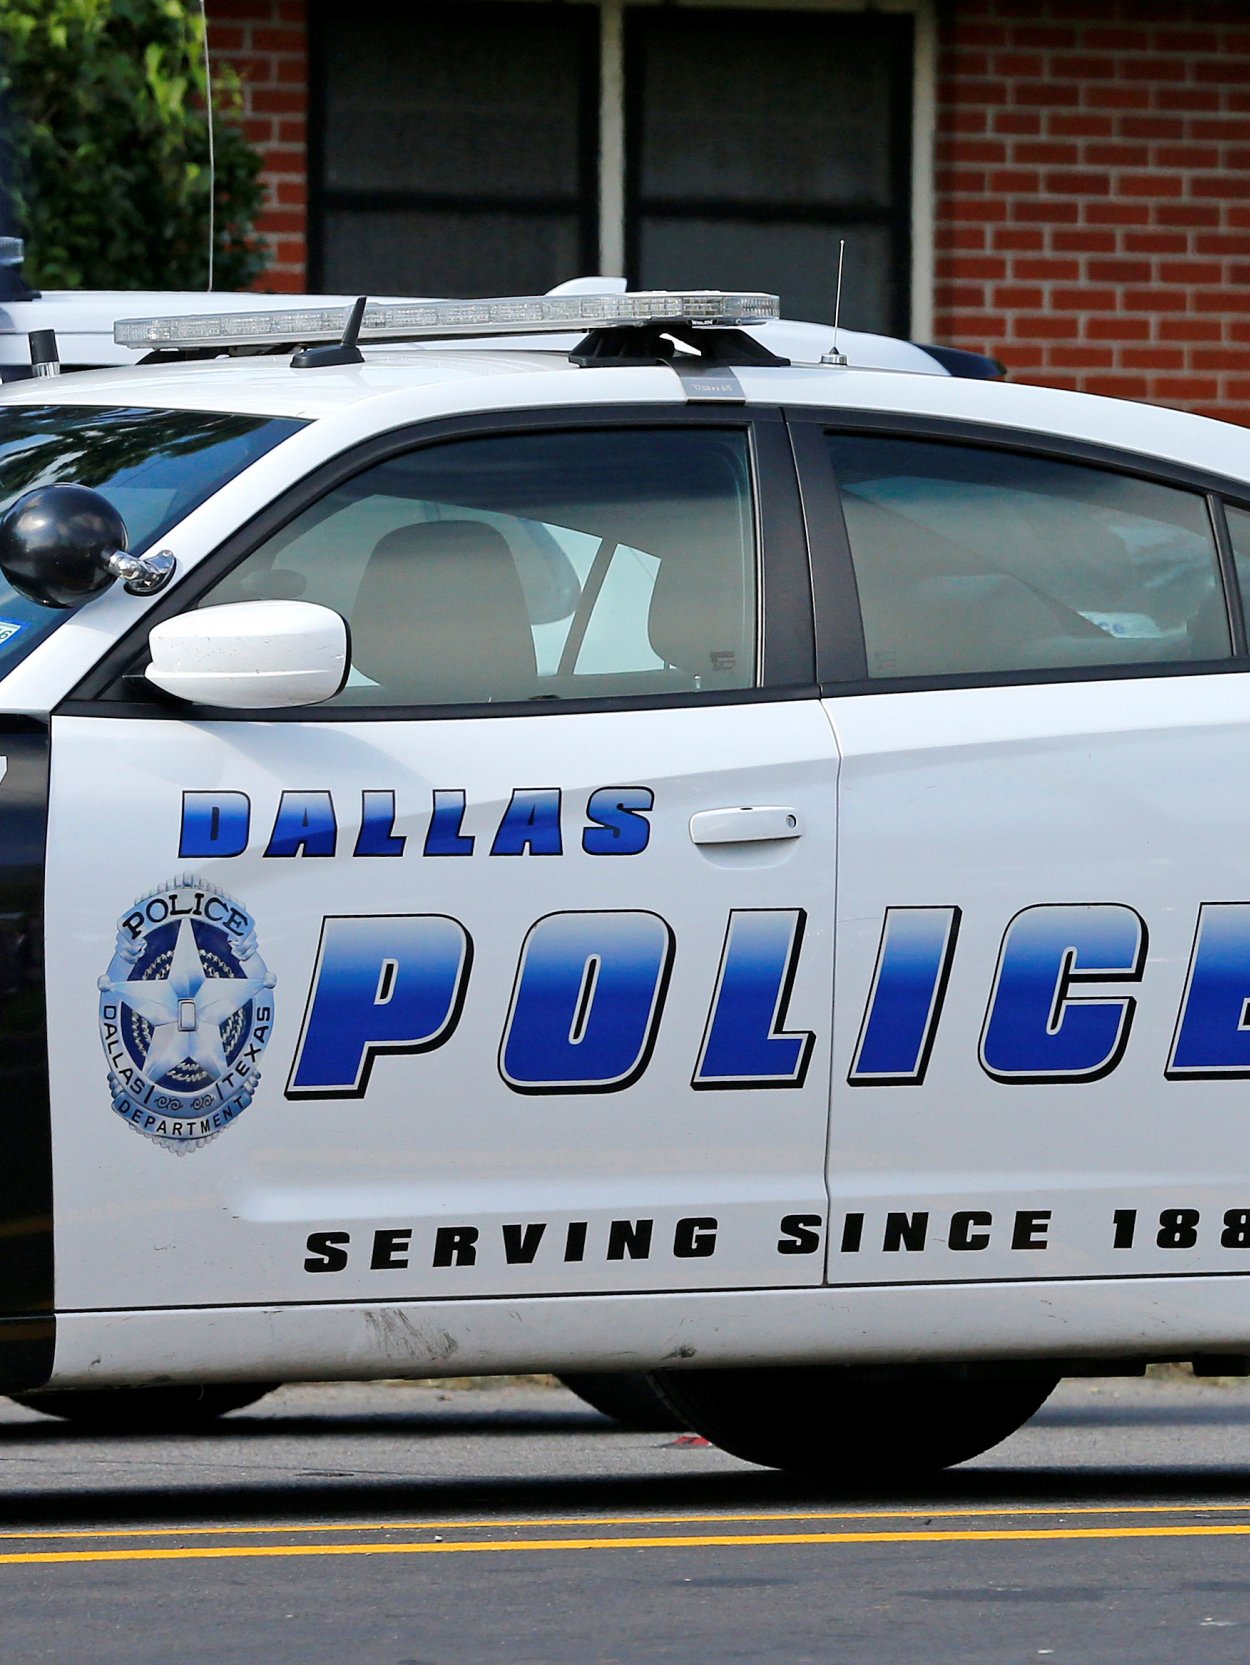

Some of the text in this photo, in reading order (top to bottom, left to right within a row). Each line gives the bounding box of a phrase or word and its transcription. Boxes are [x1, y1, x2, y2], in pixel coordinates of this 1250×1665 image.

[177, 786, 656, 859] DALLAS
[122, 893, 248, 940] POLICE
[103, 1005, 146, 1093] DALLAS
[221, 1006, 271, 1088] TEXAS
[118, 1096, 245, 1136] DEPARTMENT
[303, 1216, 719, 1274] SERVING
[776, 1210, 1053, 1256] SINCE
